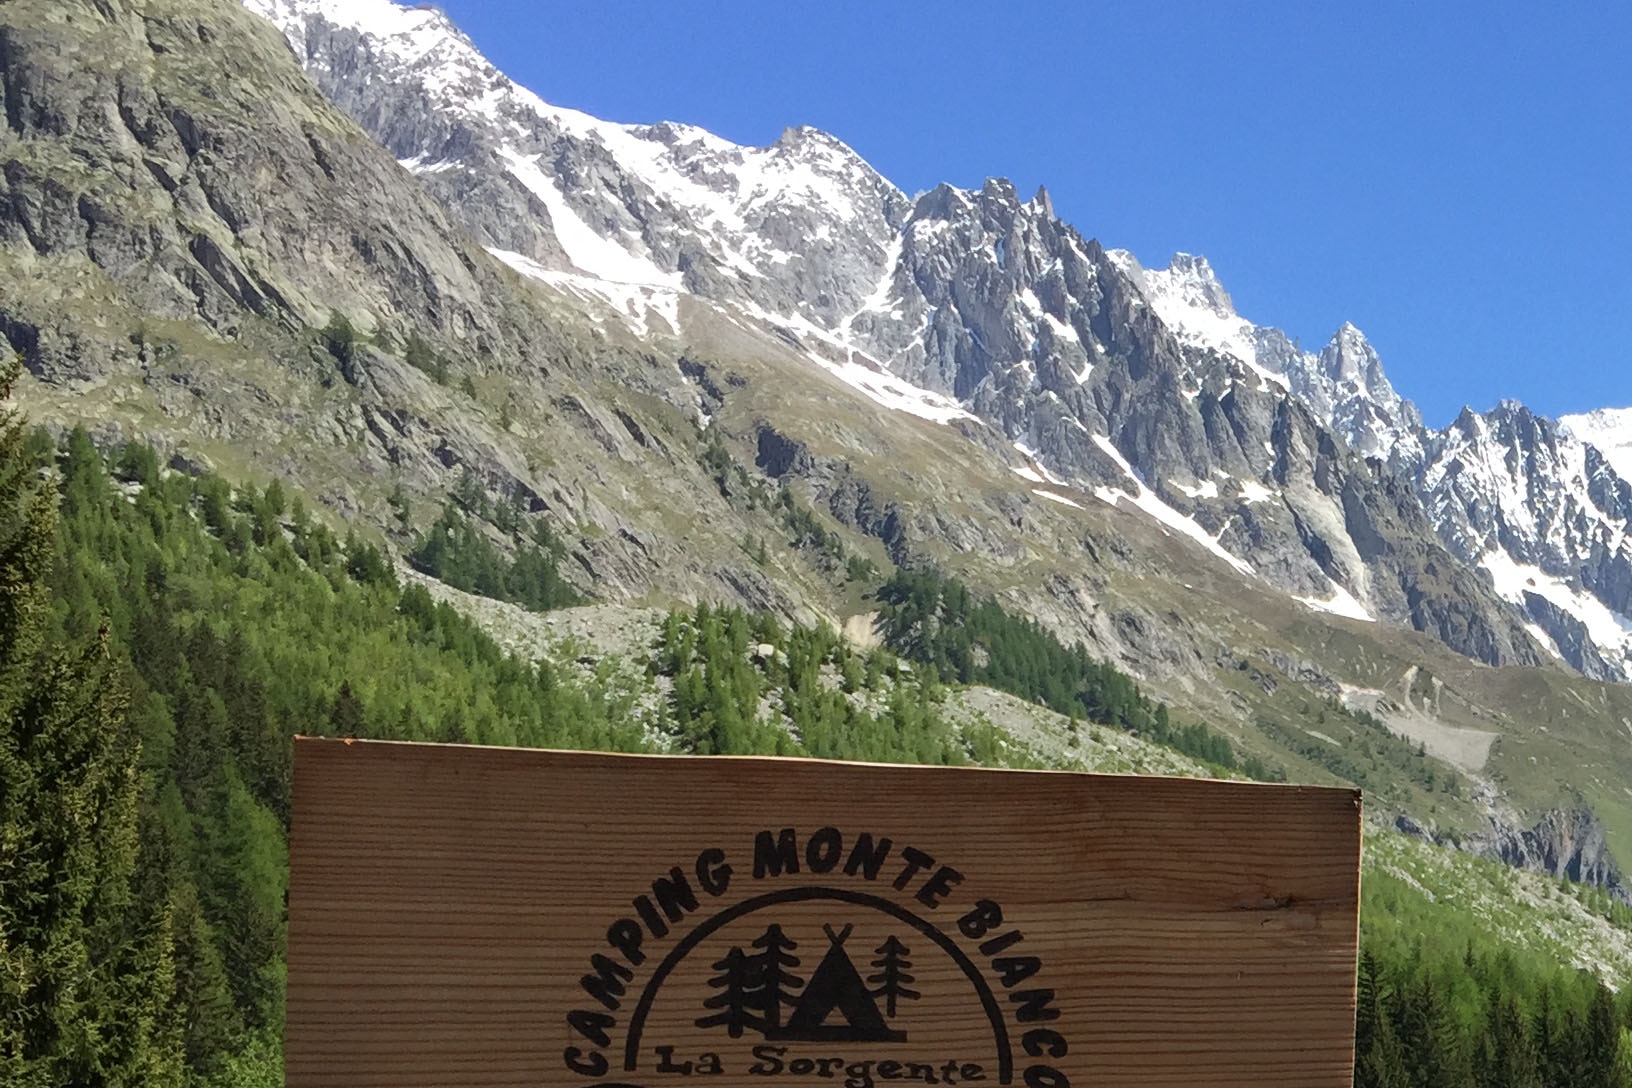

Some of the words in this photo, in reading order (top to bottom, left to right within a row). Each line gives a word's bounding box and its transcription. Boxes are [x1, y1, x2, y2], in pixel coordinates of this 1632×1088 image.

[564, 848, 733, 1076] CAMPING
[753, 826, 964, 909] MONTE
[654, 1046, 723, 1076] La
